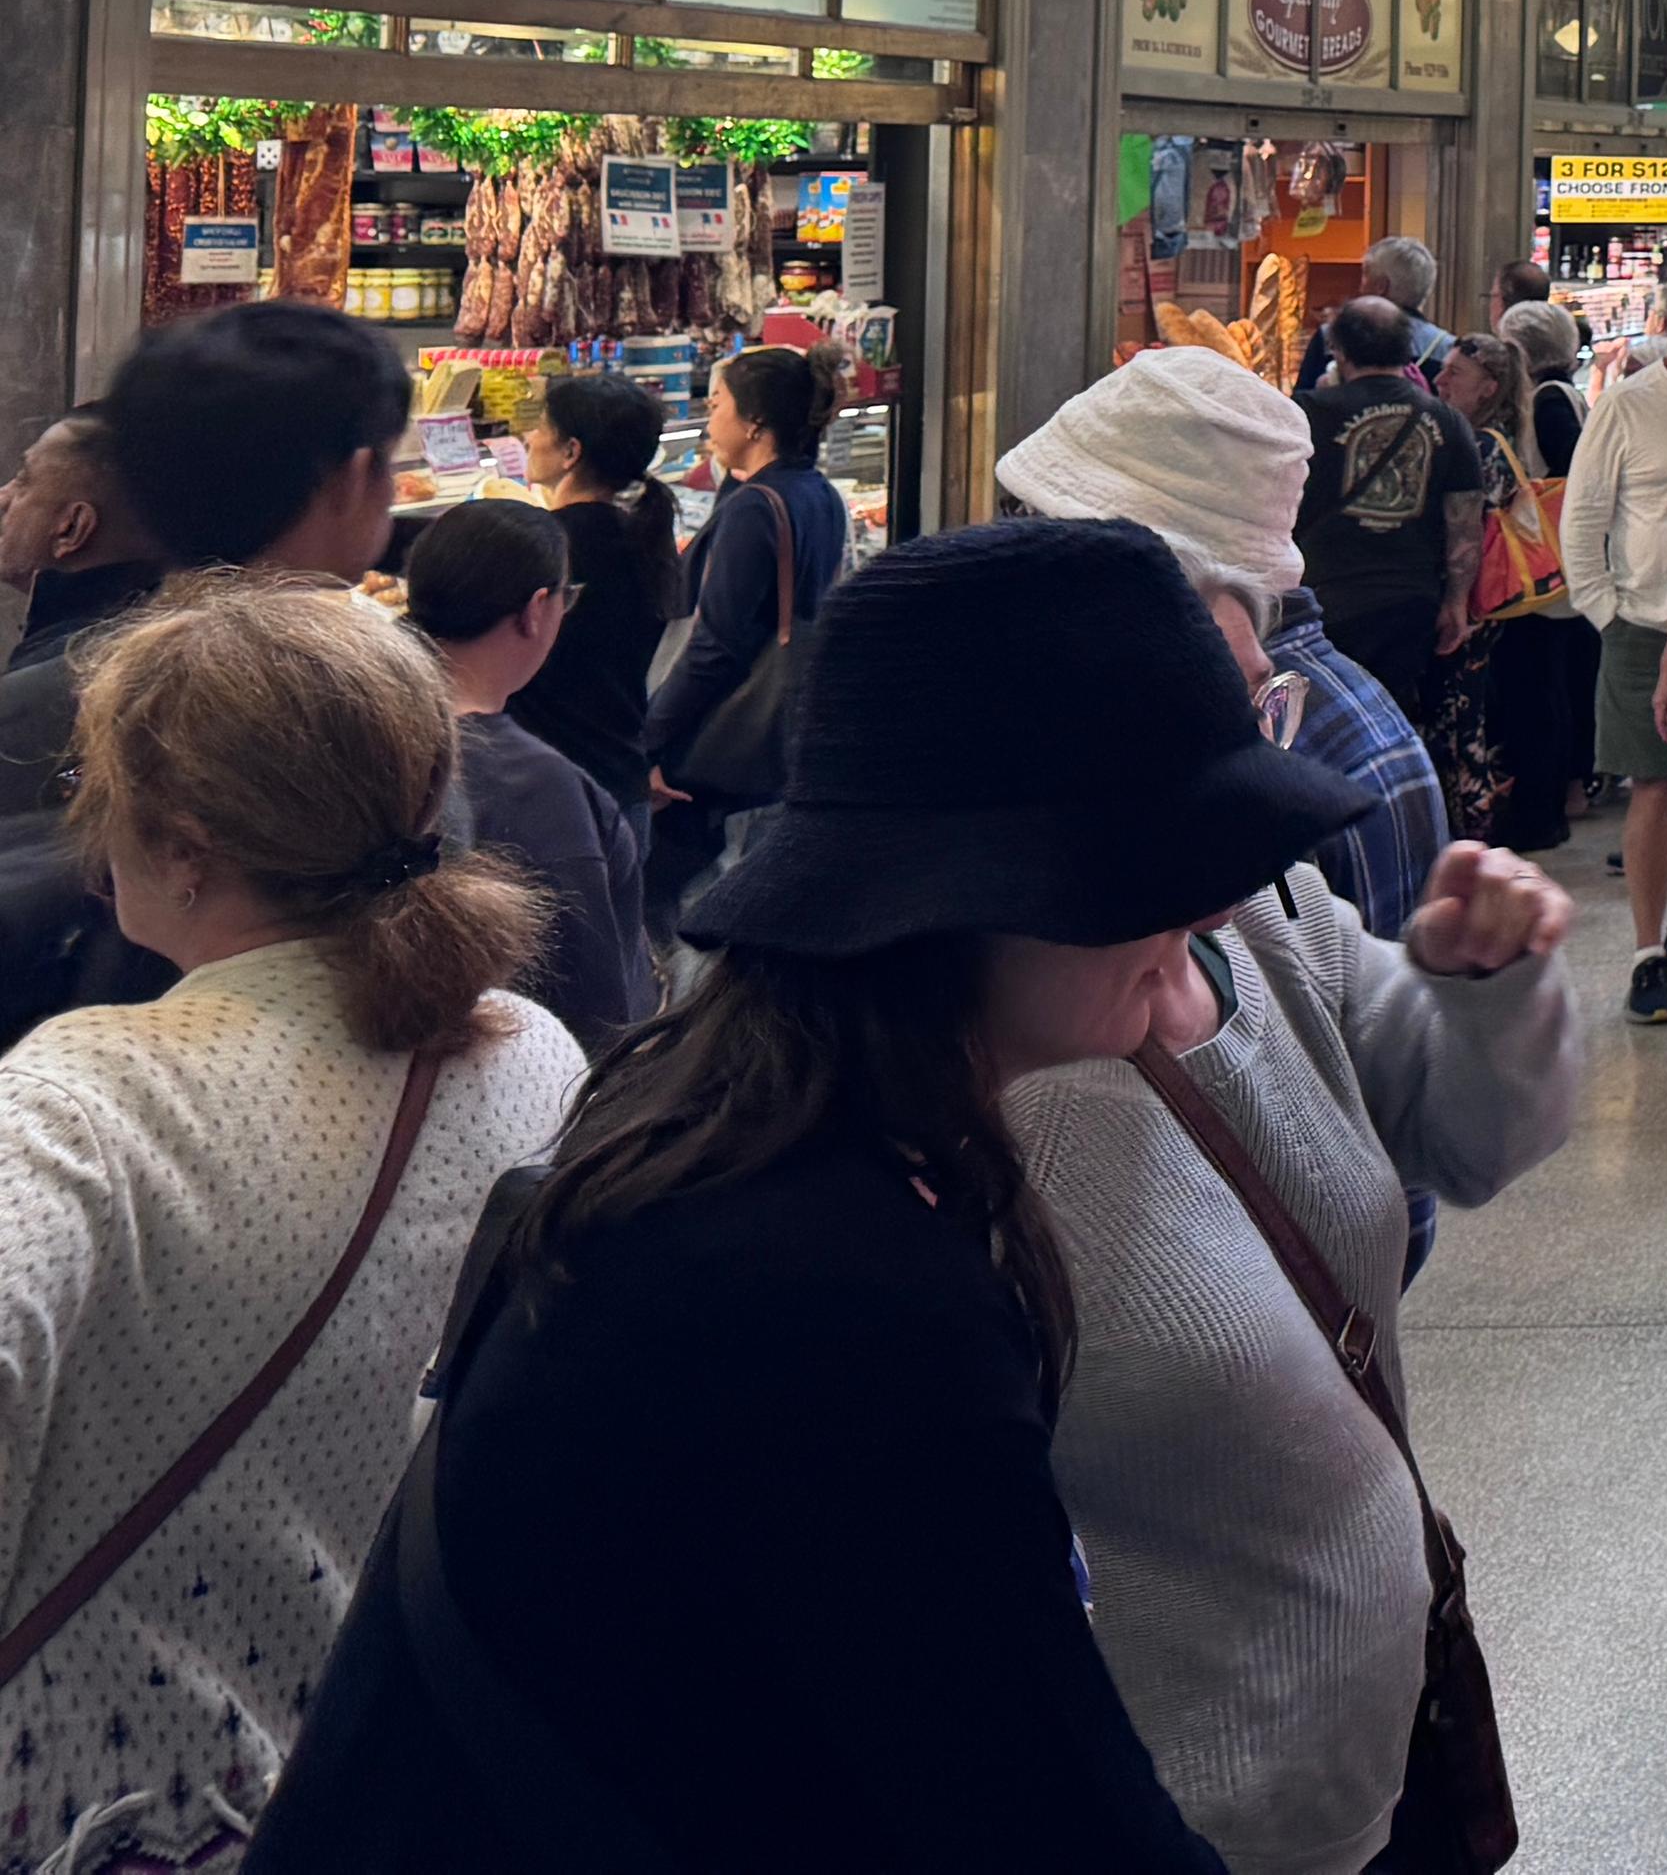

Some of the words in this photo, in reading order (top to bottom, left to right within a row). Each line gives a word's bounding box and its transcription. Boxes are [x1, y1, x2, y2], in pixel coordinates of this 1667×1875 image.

[1255, 9, 1311, 57] GOURMET
[1320, 26, 1363, 61] BREADS
[1561, 162, 1574, 178] 3
[1583, 161, 1624, 178] FOR
[1557, 181, 1624, 195] CHOOSE
